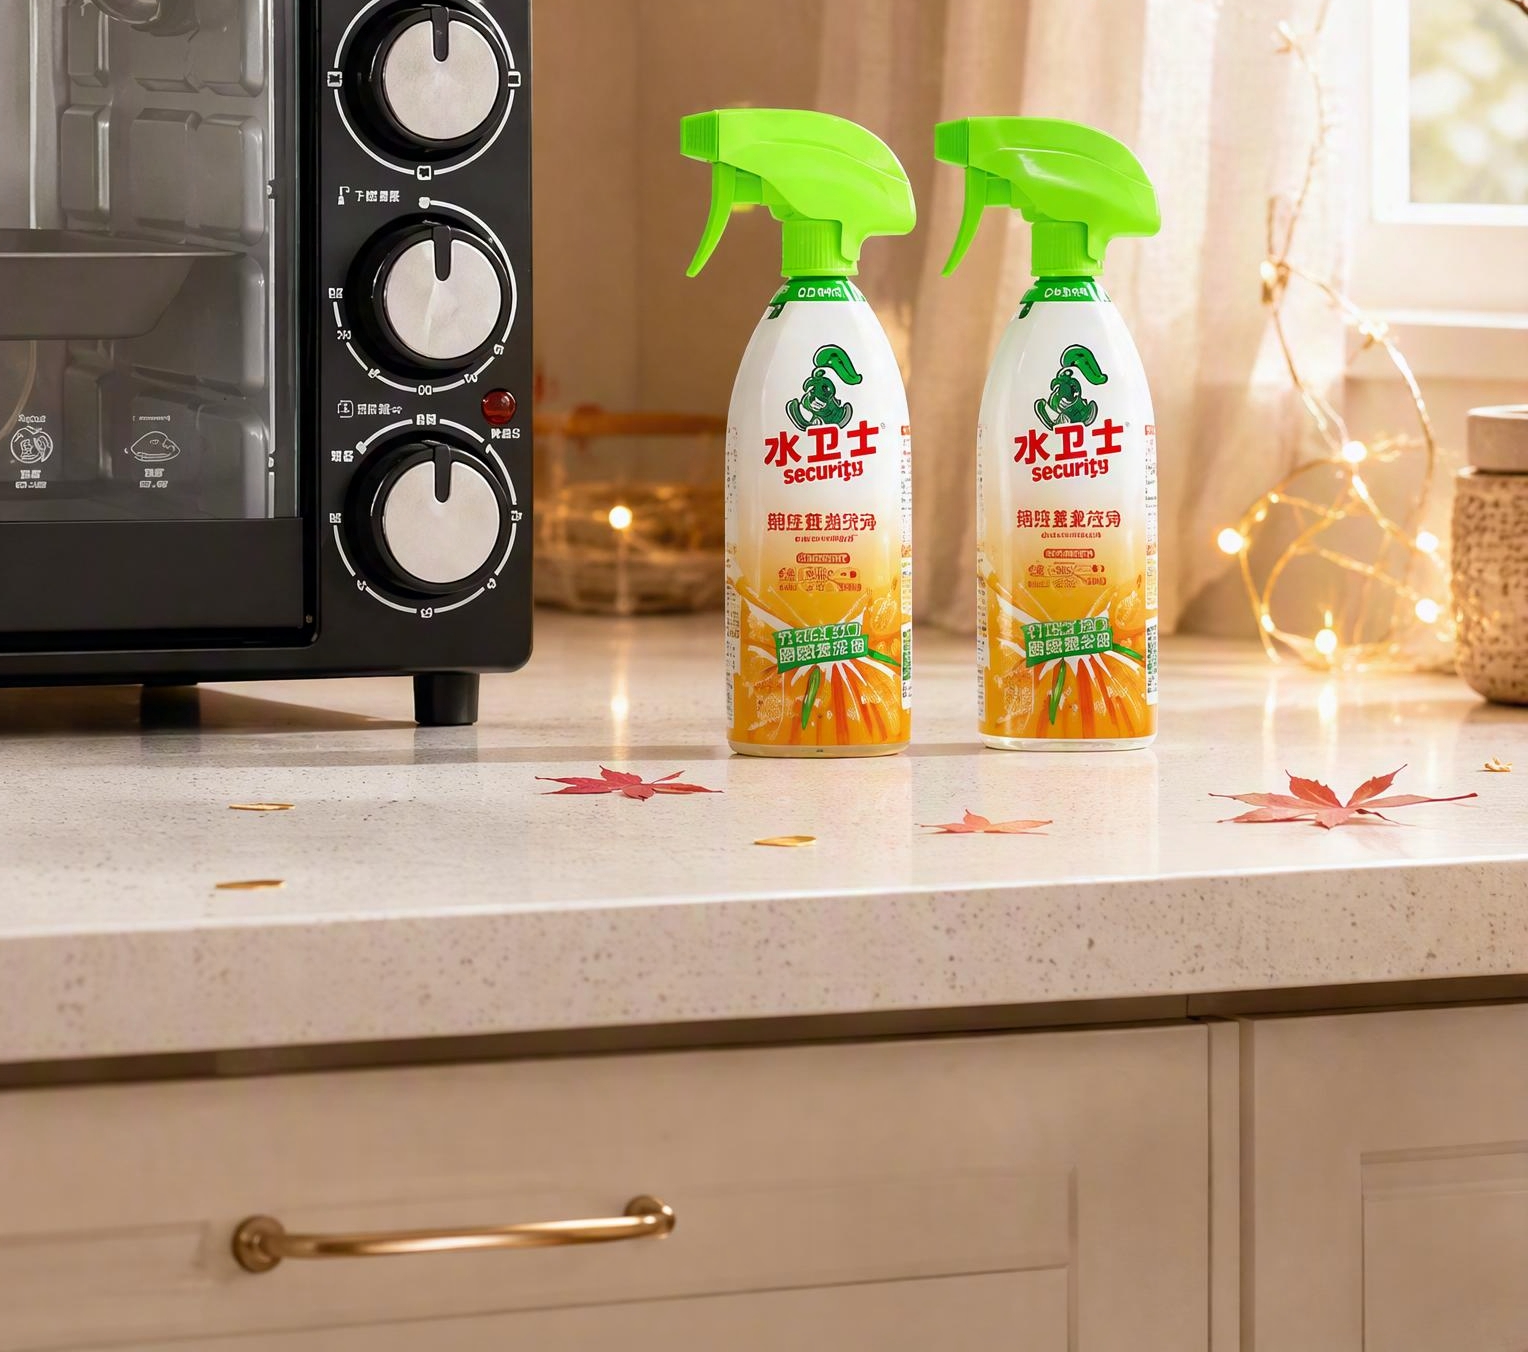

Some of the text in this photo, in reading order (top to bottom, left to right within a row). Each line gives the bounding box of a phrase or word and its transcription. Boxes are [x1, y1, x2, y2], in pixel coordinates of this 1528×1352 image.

[763, 419, 880, 467] 水卫士
[1013, 418, 1124, 465] 水卫士
[783, 459, 864, 485] security
[1031, 458, 1109, 483] security
